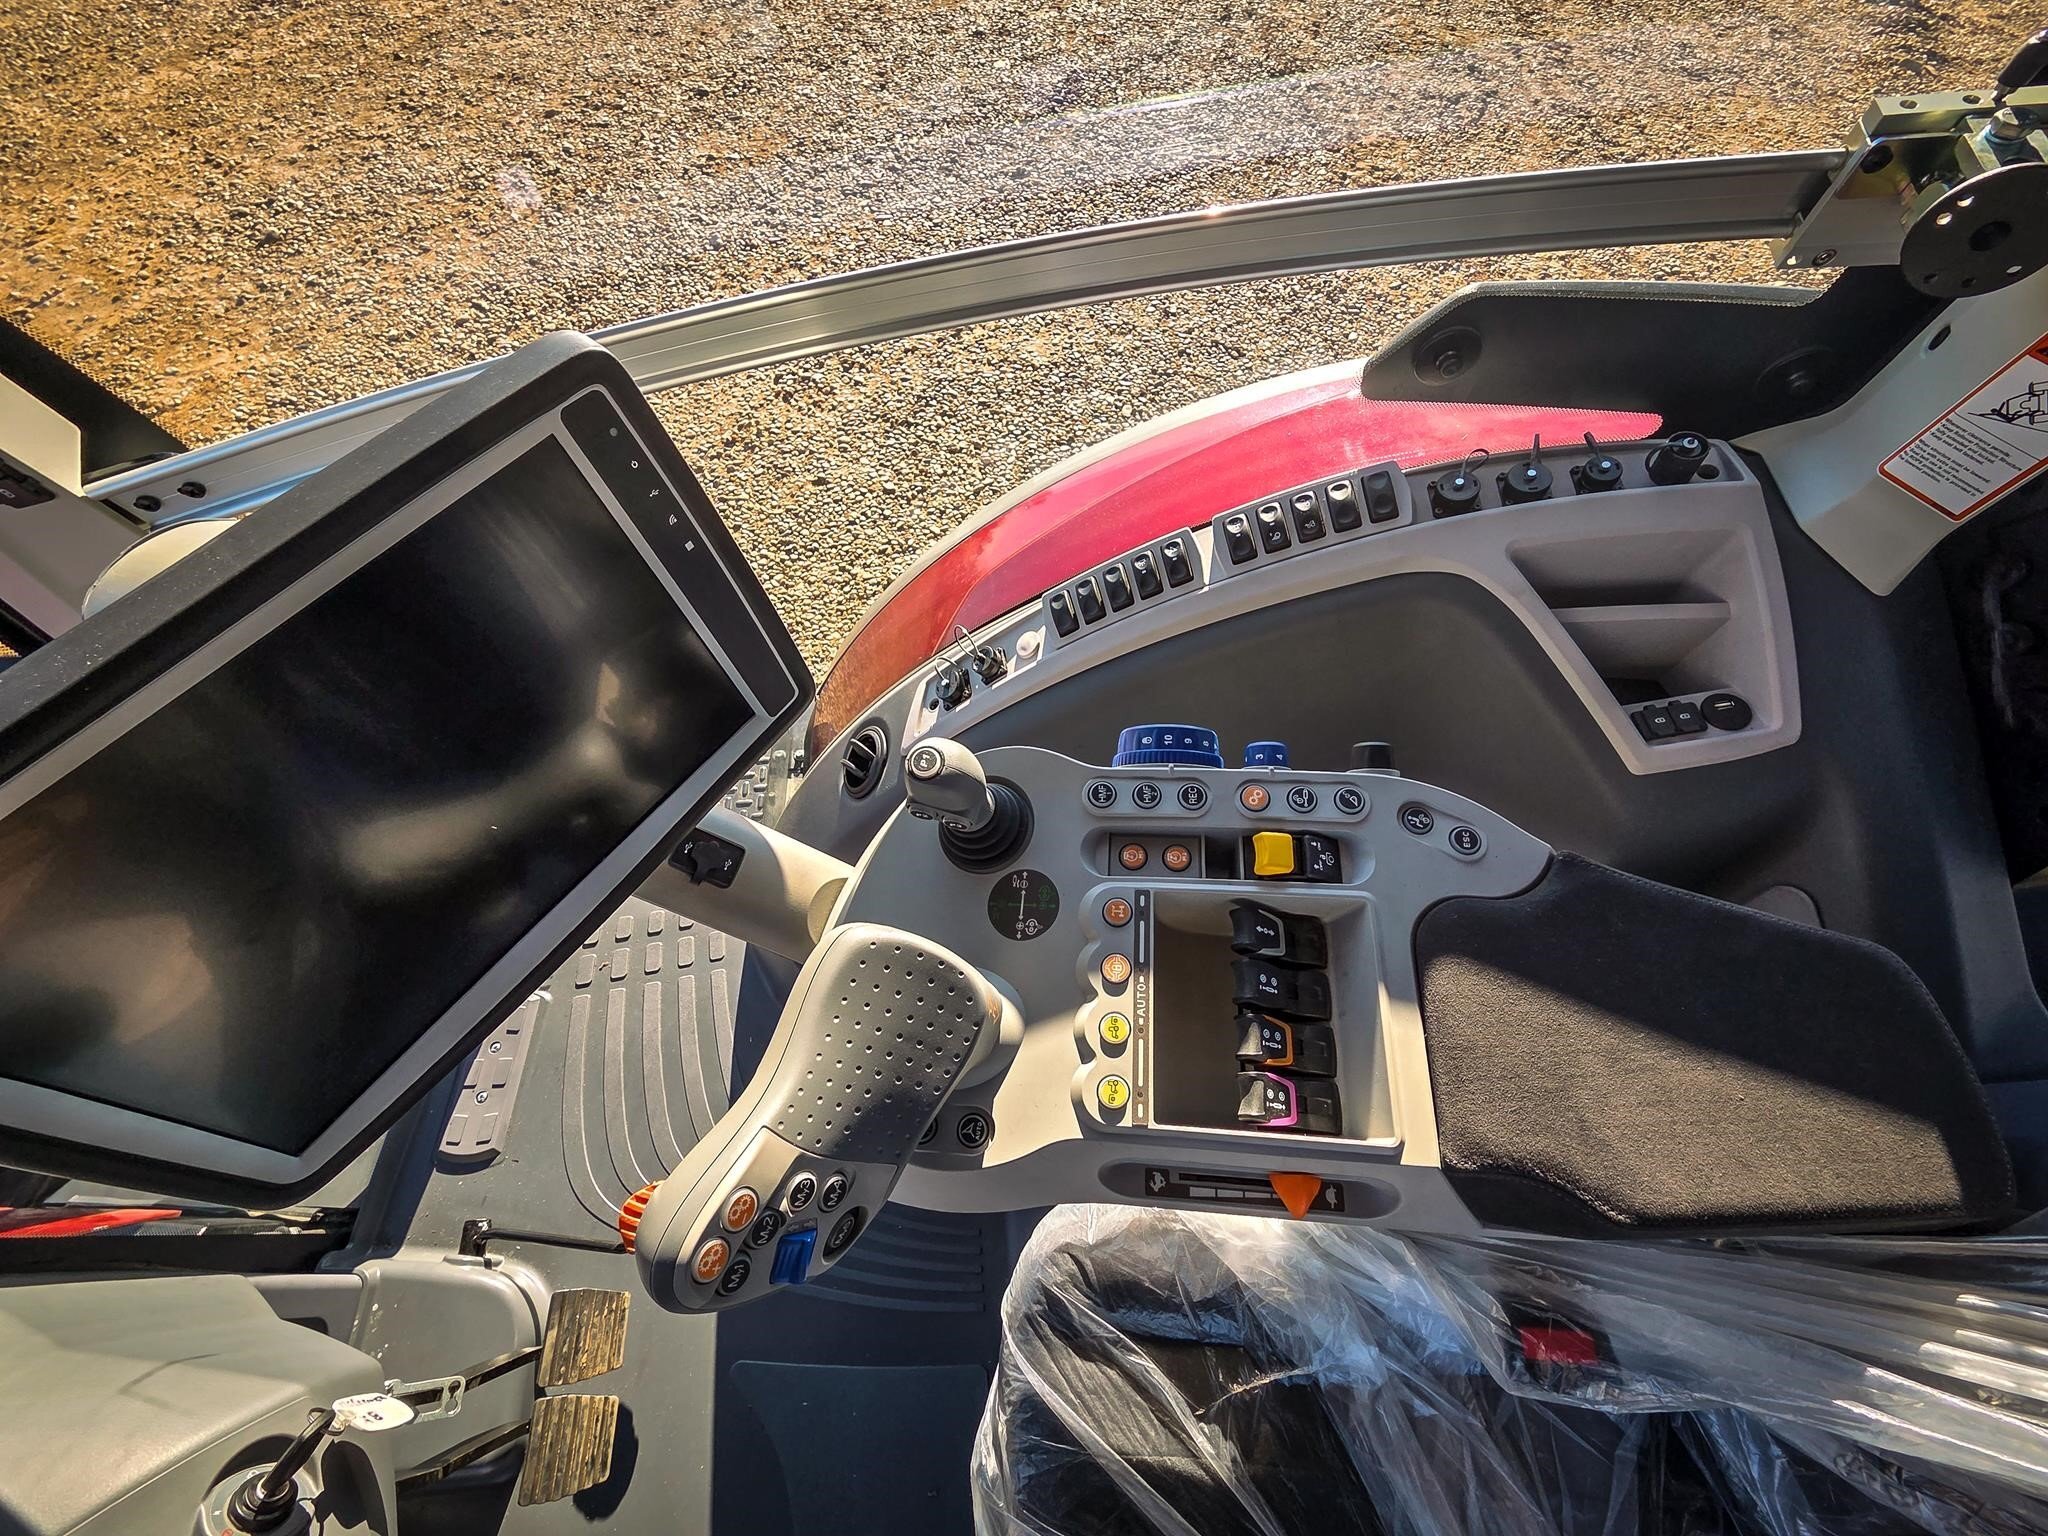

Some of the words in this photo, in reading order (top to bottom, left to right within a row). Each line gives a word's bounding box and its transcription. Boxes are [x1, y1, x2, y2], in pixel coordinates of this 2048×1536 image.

[1164, 734, 1173, 745] 10
[920, 753, 930, 768] P1
[1189, 787, 1198, 804] REC
[1462, 831, 1471, 848] ESC
[1136, 983, 1147, 1017] AUTO
[795, 1179, 811, 1206] My3
[828, 1179, 843, 1206] My4
[757, 1215, 775, 1244] My2
[728, 1264, 745, 1288] My1
